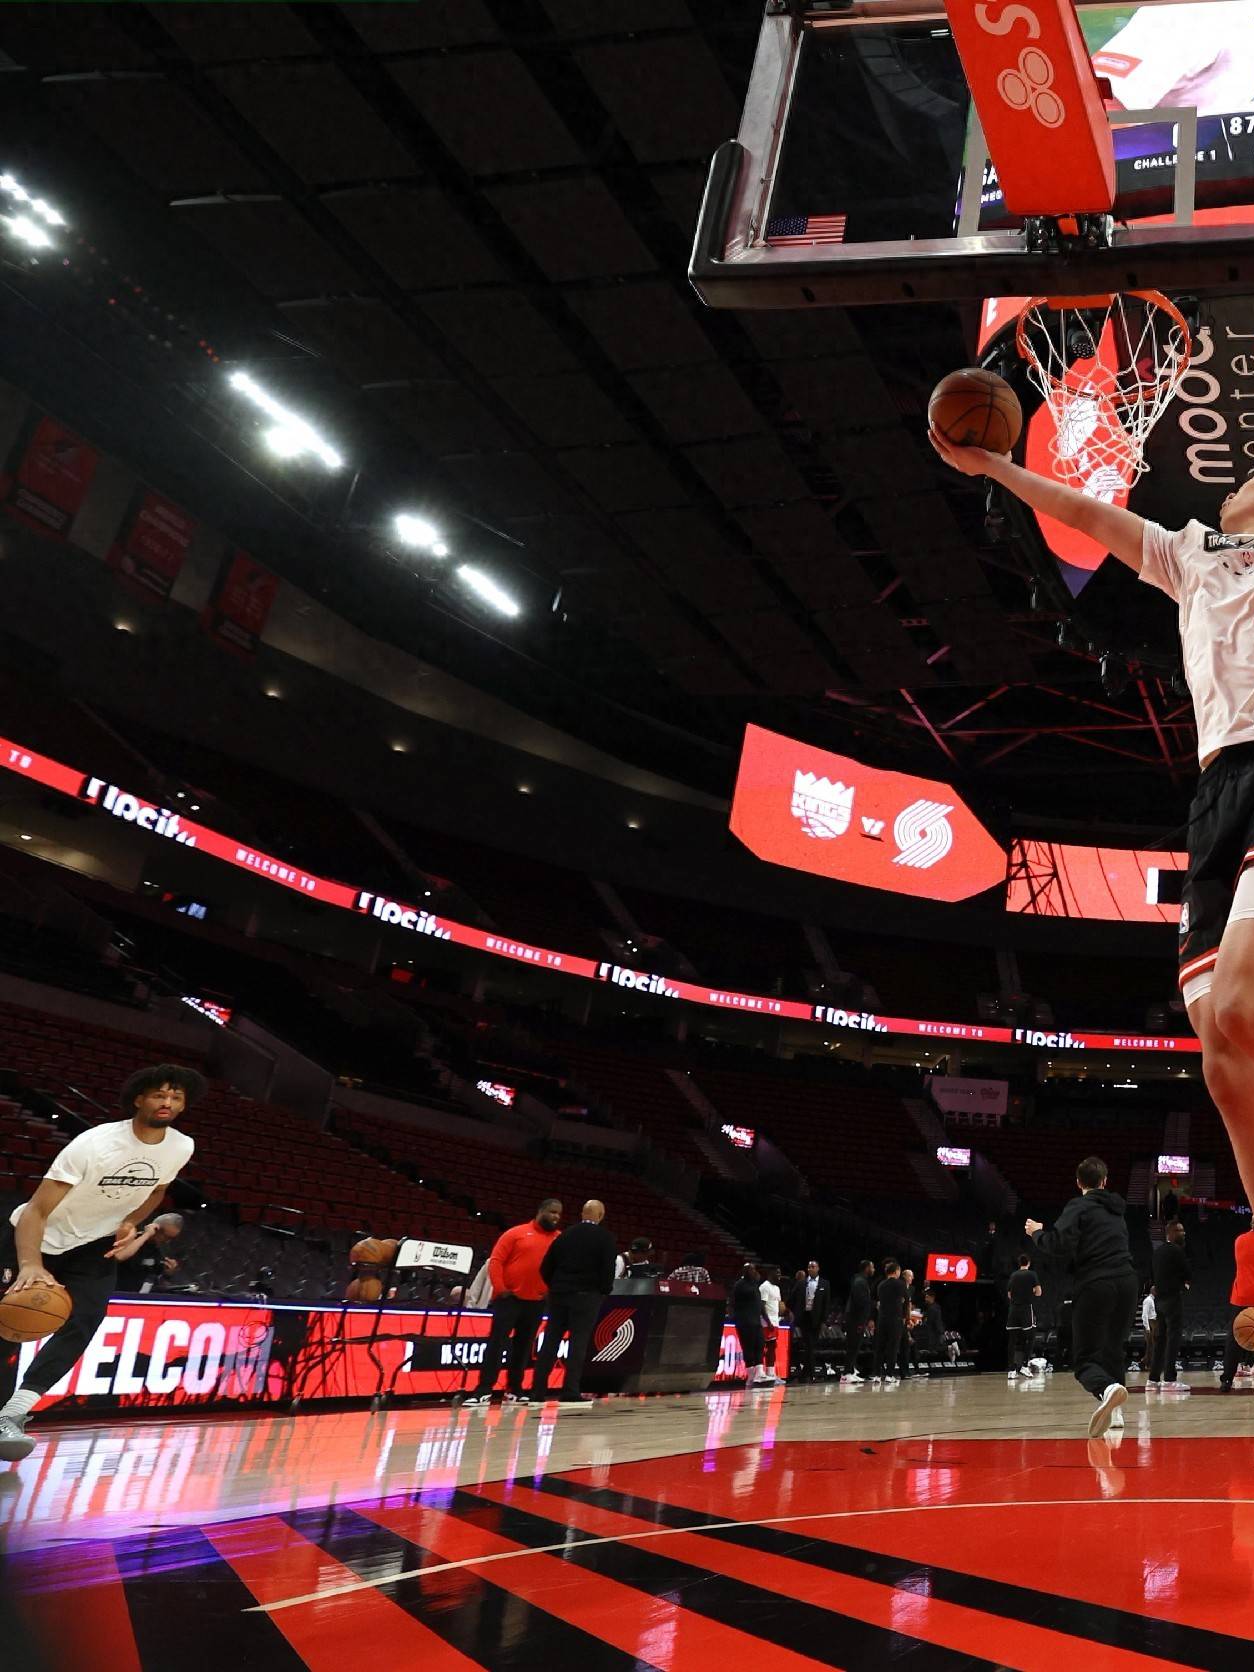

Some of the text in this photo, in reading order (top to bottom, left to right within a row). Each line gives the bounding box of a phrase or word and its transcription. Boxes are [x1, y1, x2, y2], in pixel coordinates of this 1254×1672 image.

[1134, 149, 1204, 170] CHALLEE
[235, 849, 296, 883] WELCOME
[486, 937, 541, 961] WELCOME
[709, 993, 762, 1009] WELCOME
[918, 1023, 966, 1036] WELCOME
[1113, 1038, 1159, 1048] WELCOME
[433, 1246, 459, 1260] Wilson
